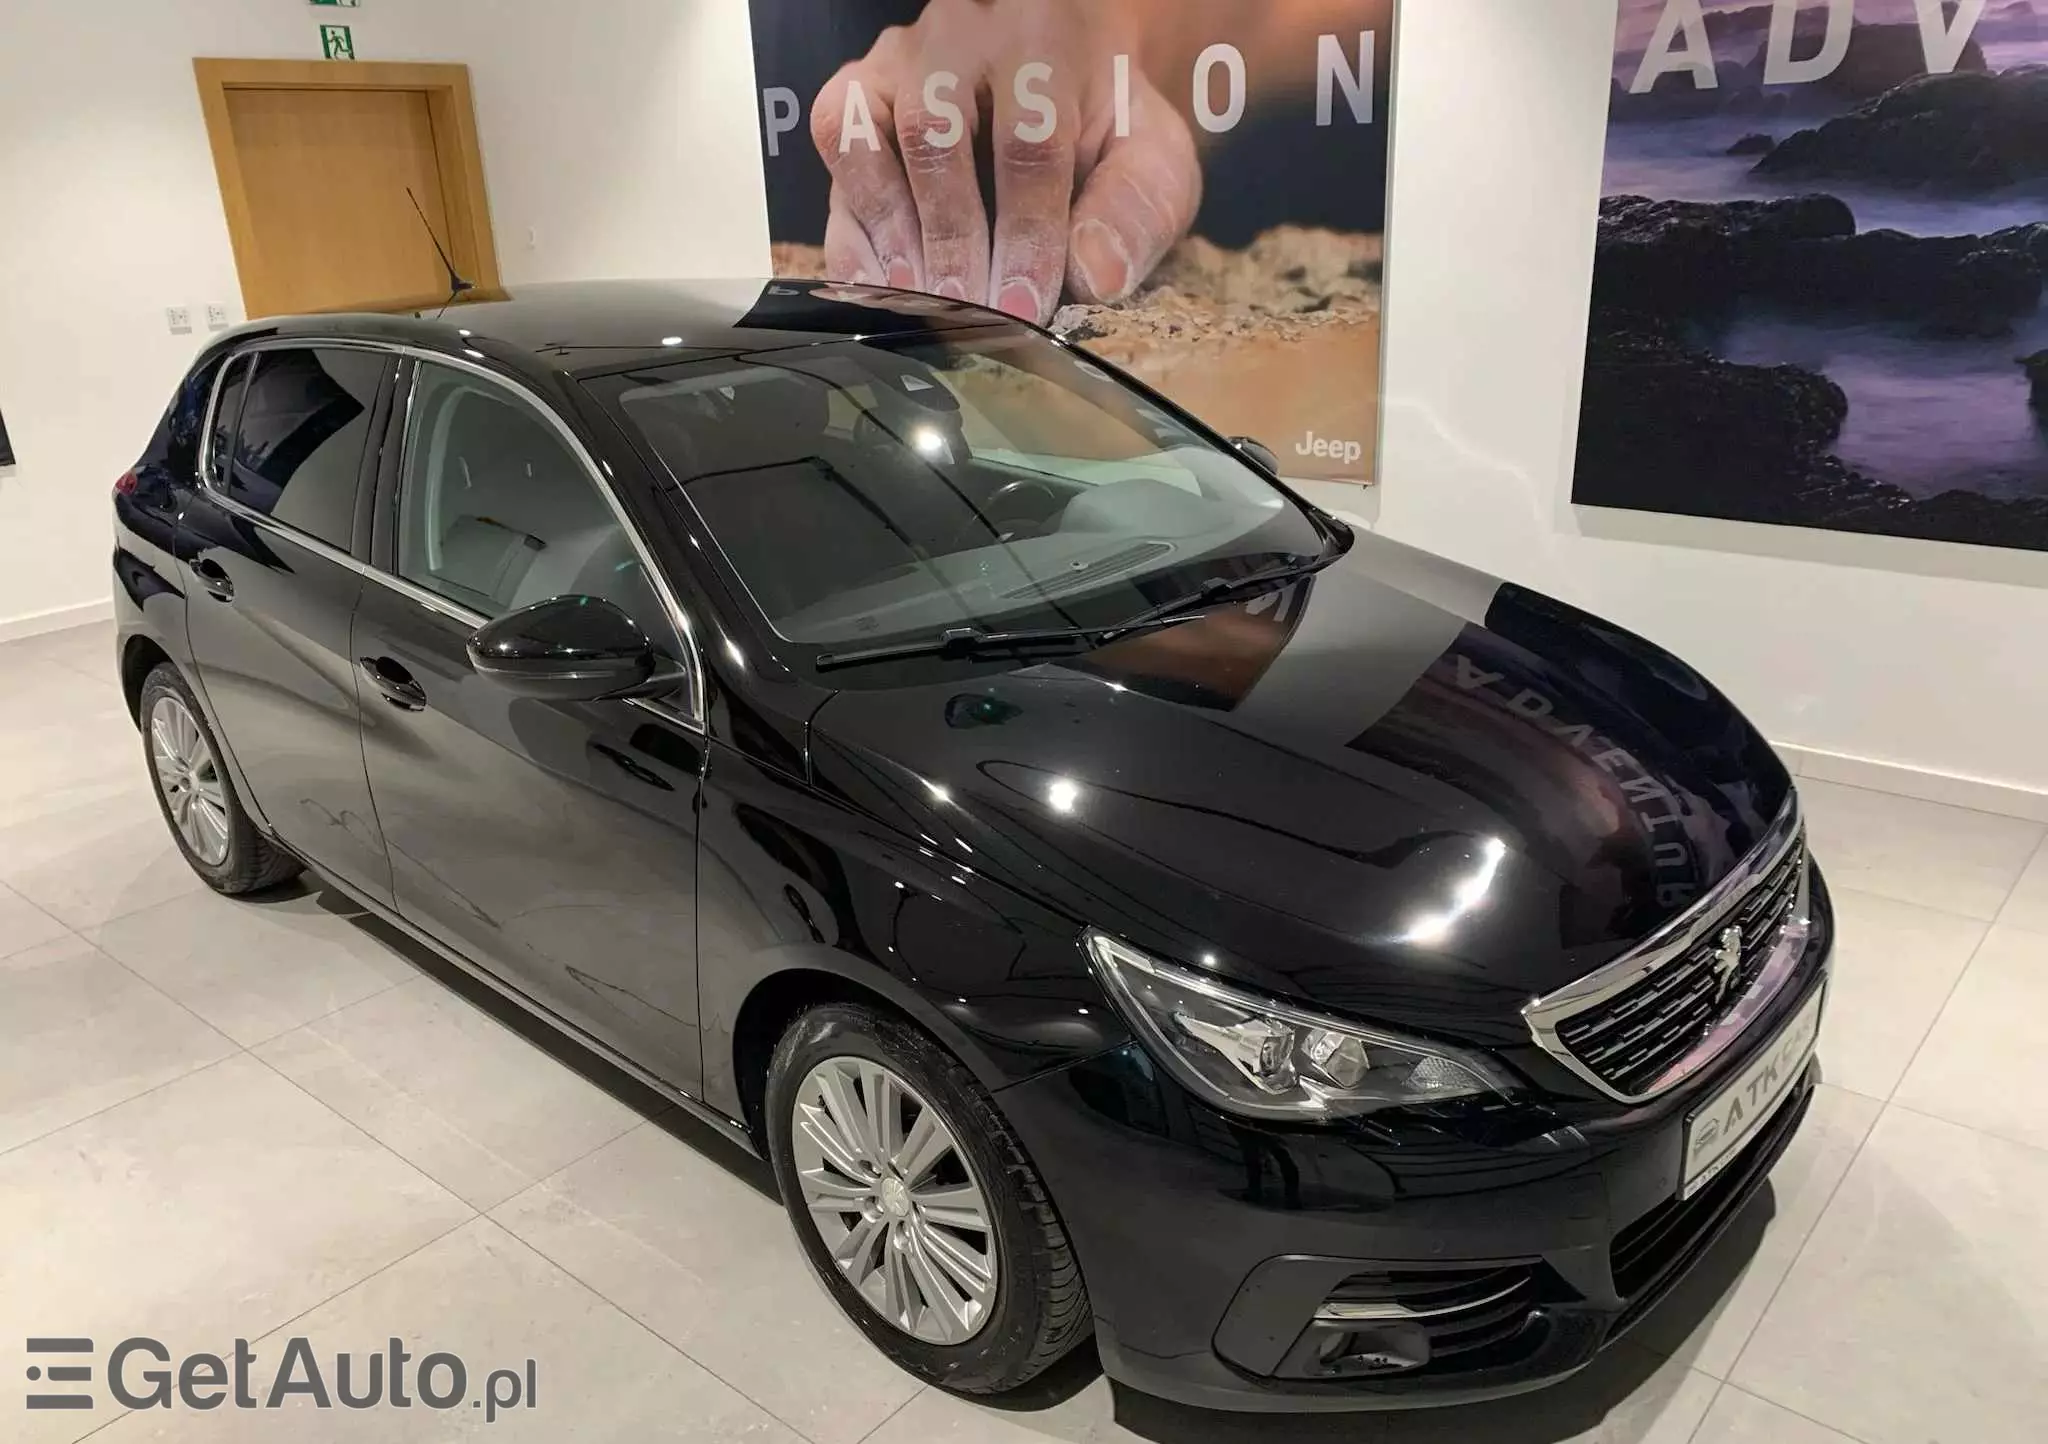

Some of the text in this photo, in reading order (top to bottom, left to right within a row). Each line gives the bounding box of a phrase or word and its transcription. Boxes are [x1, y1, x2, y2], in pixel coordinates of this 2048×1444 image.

[1629, 0, 1986, 93] ADV
[763, 30, 1376, 157] PASSION
[1295, 431, 1361, 465] Jeep
